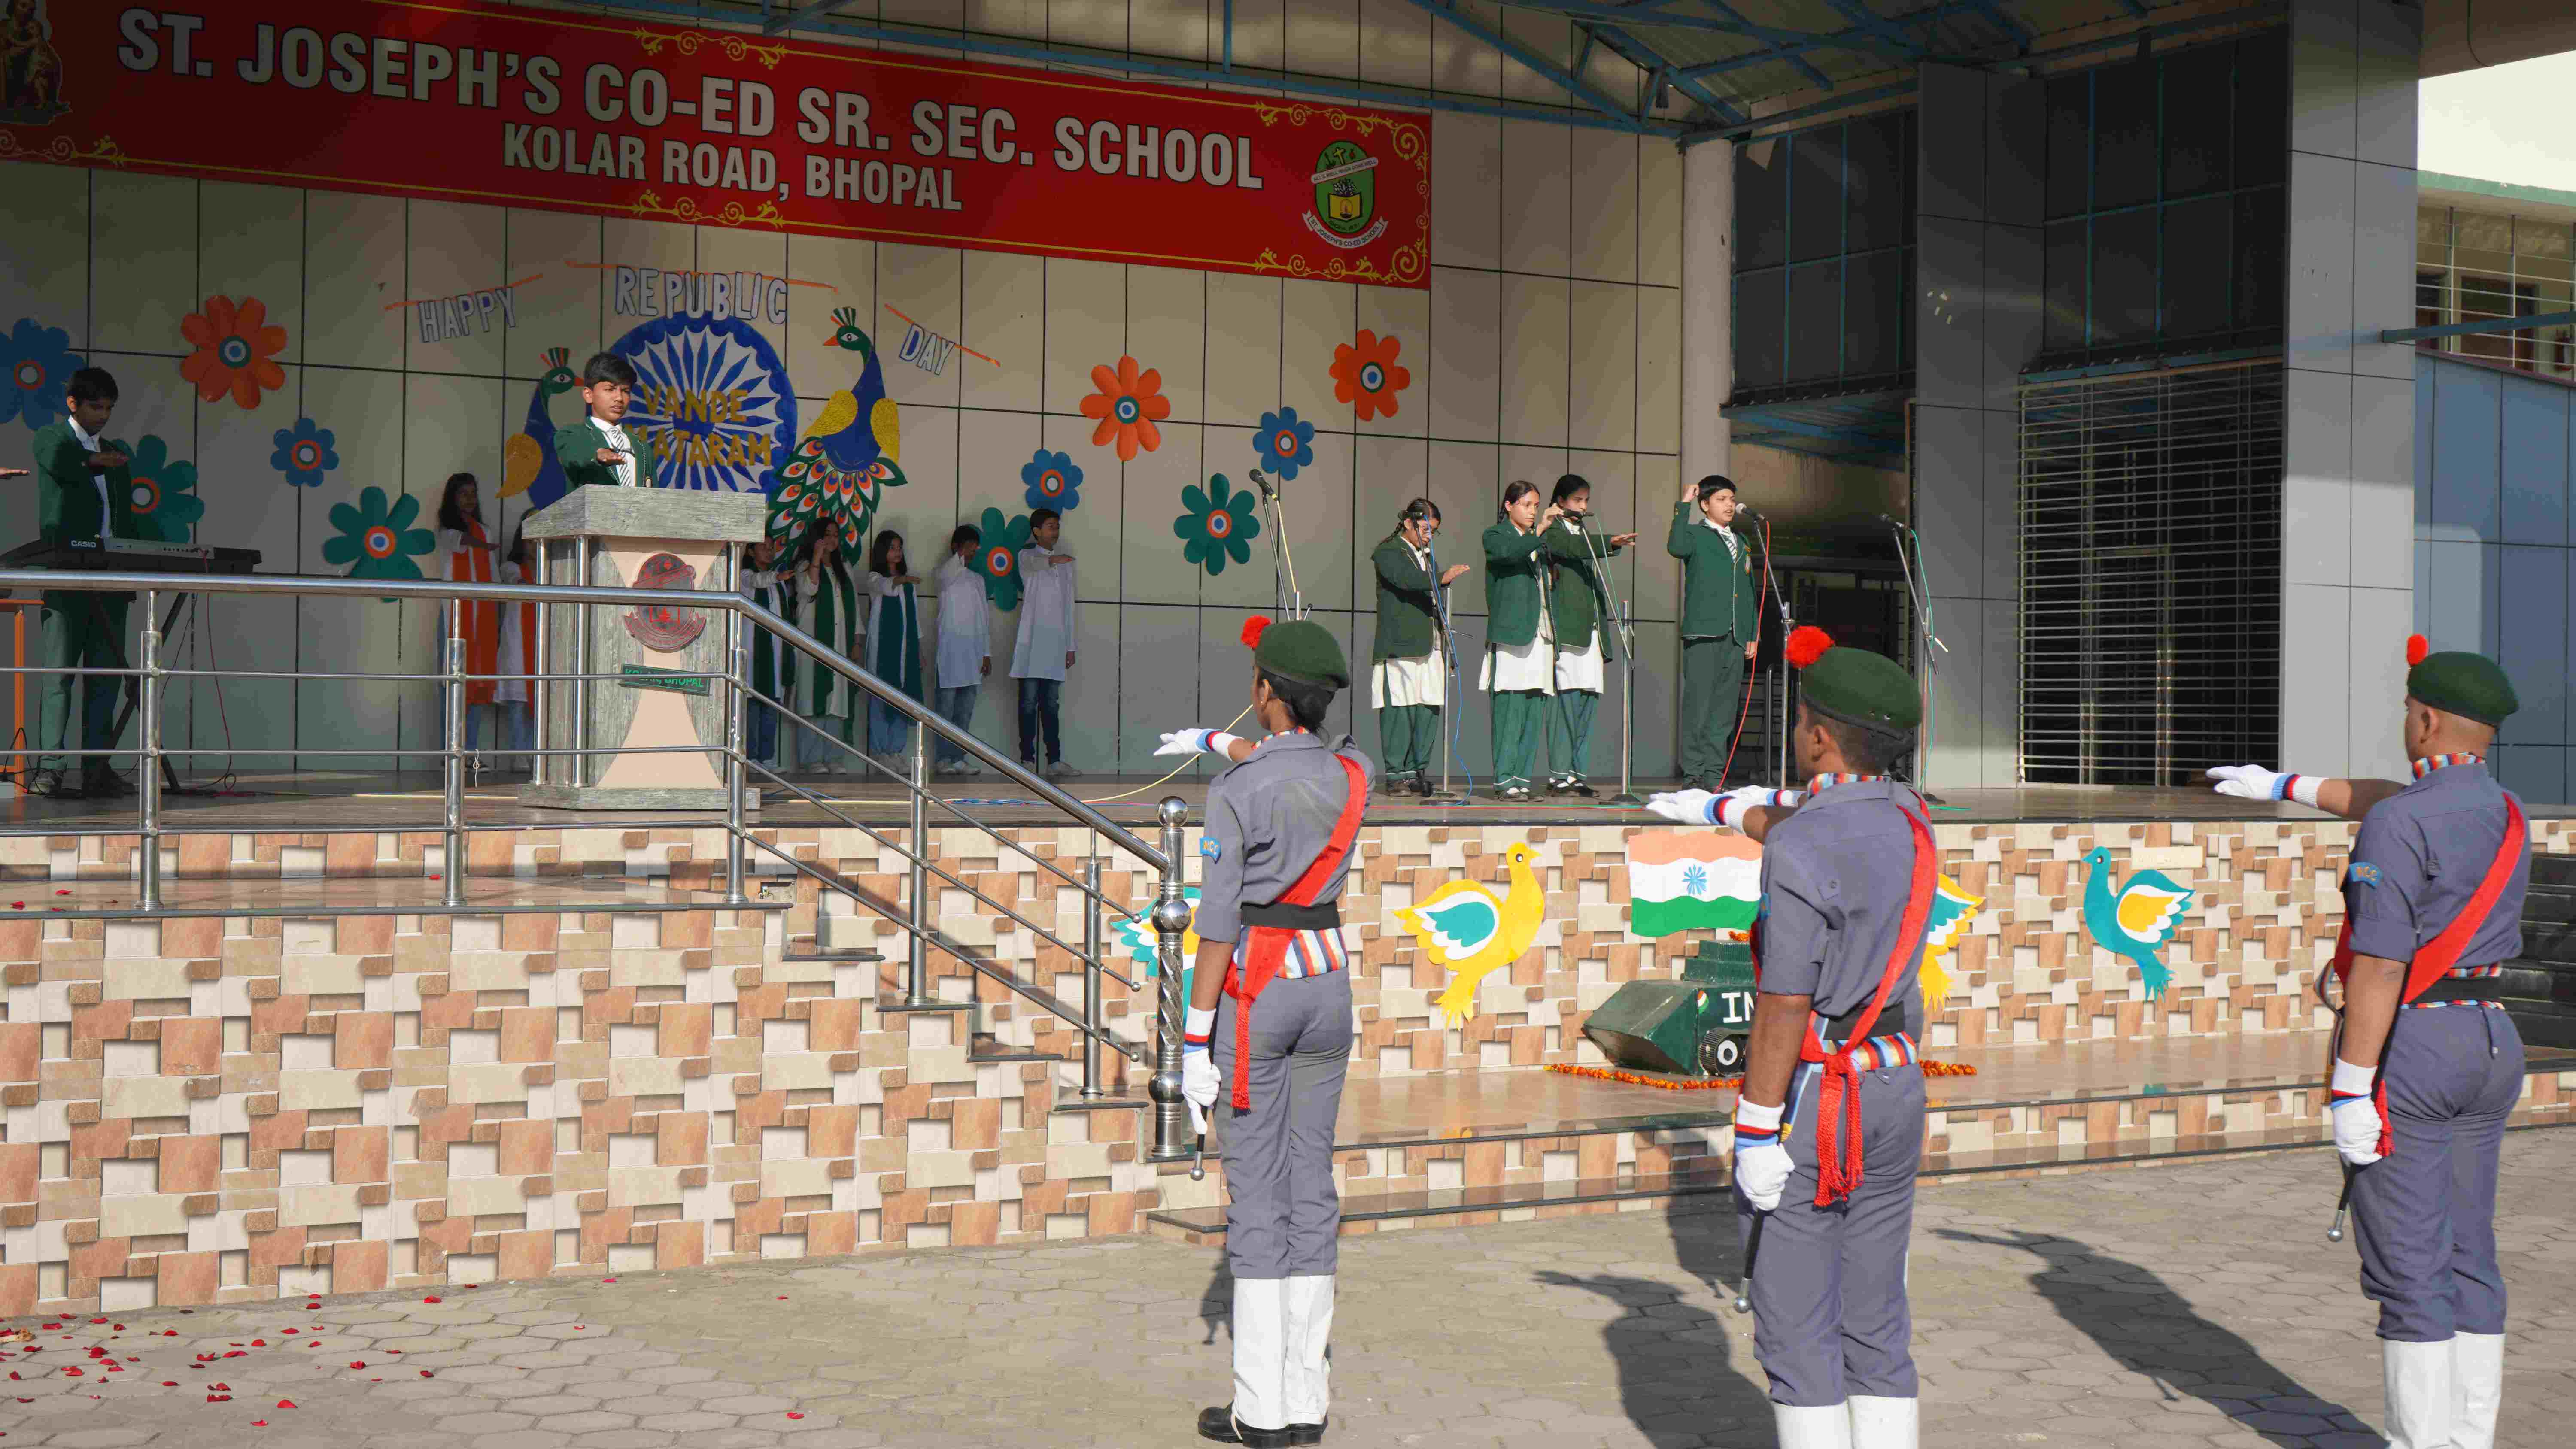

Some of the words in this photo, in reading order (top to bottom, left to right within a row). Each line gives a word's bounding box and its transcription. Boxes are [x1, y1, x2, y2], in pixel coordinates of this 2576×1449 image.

[118, 8, 213, 78] ST.
[237, 23, 562, 115] JOSEPH'S
[584, 63, 775, 137] CO-ED
[796, 86, 890, 151] SR.
[911, 100, 1034, 166] SEC.
[1053, 116, 1264, 190] SCHOOL
[503, 122, 647, 181] KOLAR
[662, 139, 790, 202] ROAD,
[805, 154, 963, 211] BHOPAL
[418, 286, 516, 343] HAPPY
[615, 266, 787, 324] REPUBLIC
[899, 322, 955, 375] DAY
[641, 383, 748, 423] VANDE
[1203, 840, 1219, 854] NCC
